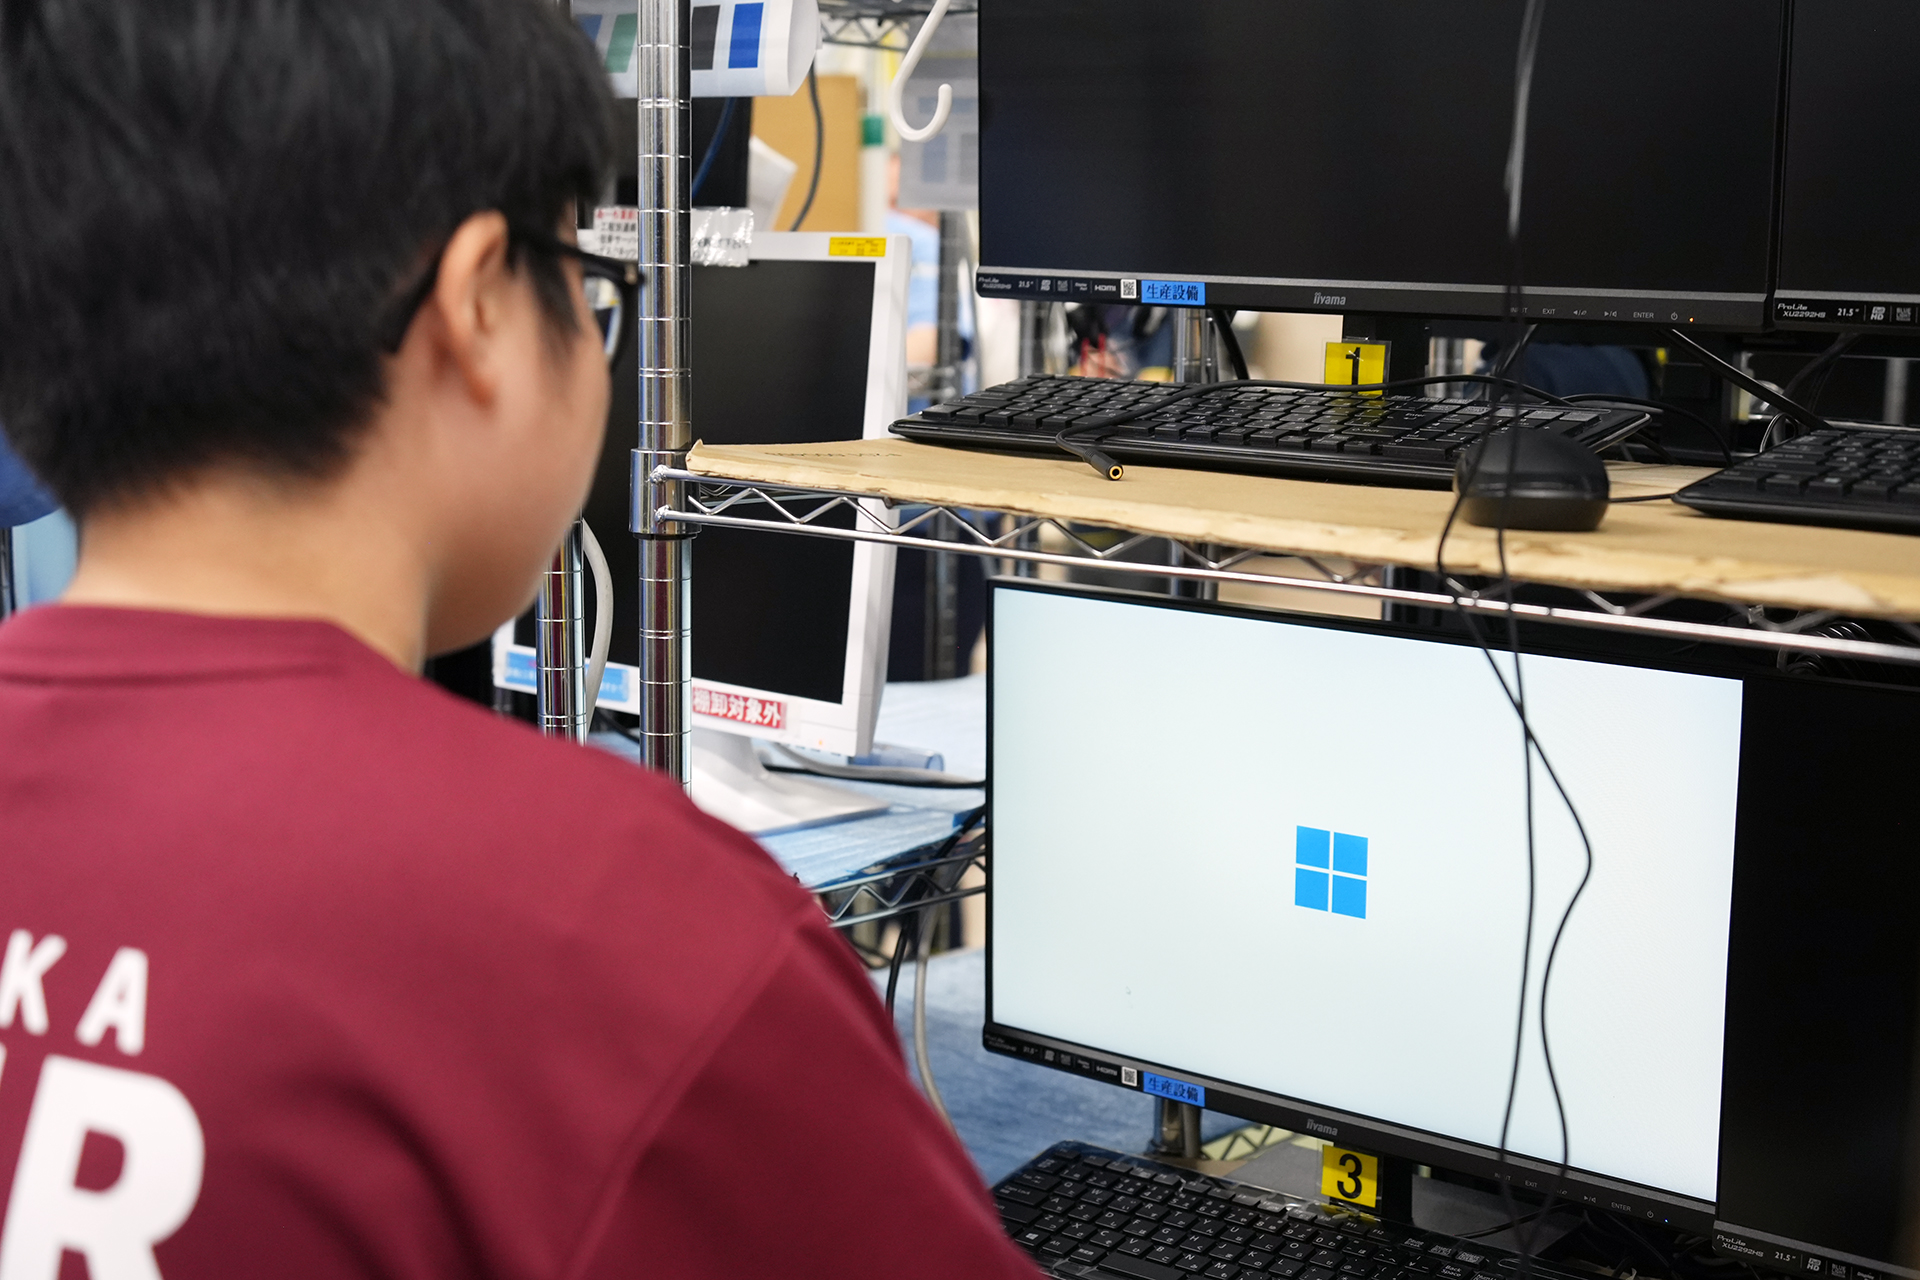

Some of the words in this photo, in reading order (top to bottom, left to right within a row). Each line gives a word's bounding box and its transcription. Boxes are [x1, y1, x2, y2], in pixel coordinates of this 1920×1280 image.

[1146, 283, 1199, 302] 生産設備
[1313, 292, 1346, 306] iiyama
[1346, 347, 1361, 391] 1
[693, 689, 781, 727] 棚卸対象外
[0, 928, 149, 1056] KA
[1148, 1076, 1198, 1102] 生産設備
[1306, 1118, 1338, 1136] iiyama
[0, 1041, 206, 1280] R
[1337, 1153, 1362, 1200] 3
[1611, 1202, 1632, 1212] ENTER
[1716, 1234, 1746, 1246] ProLite
[1722, 1242, 1764, 1258] XU2292HS
